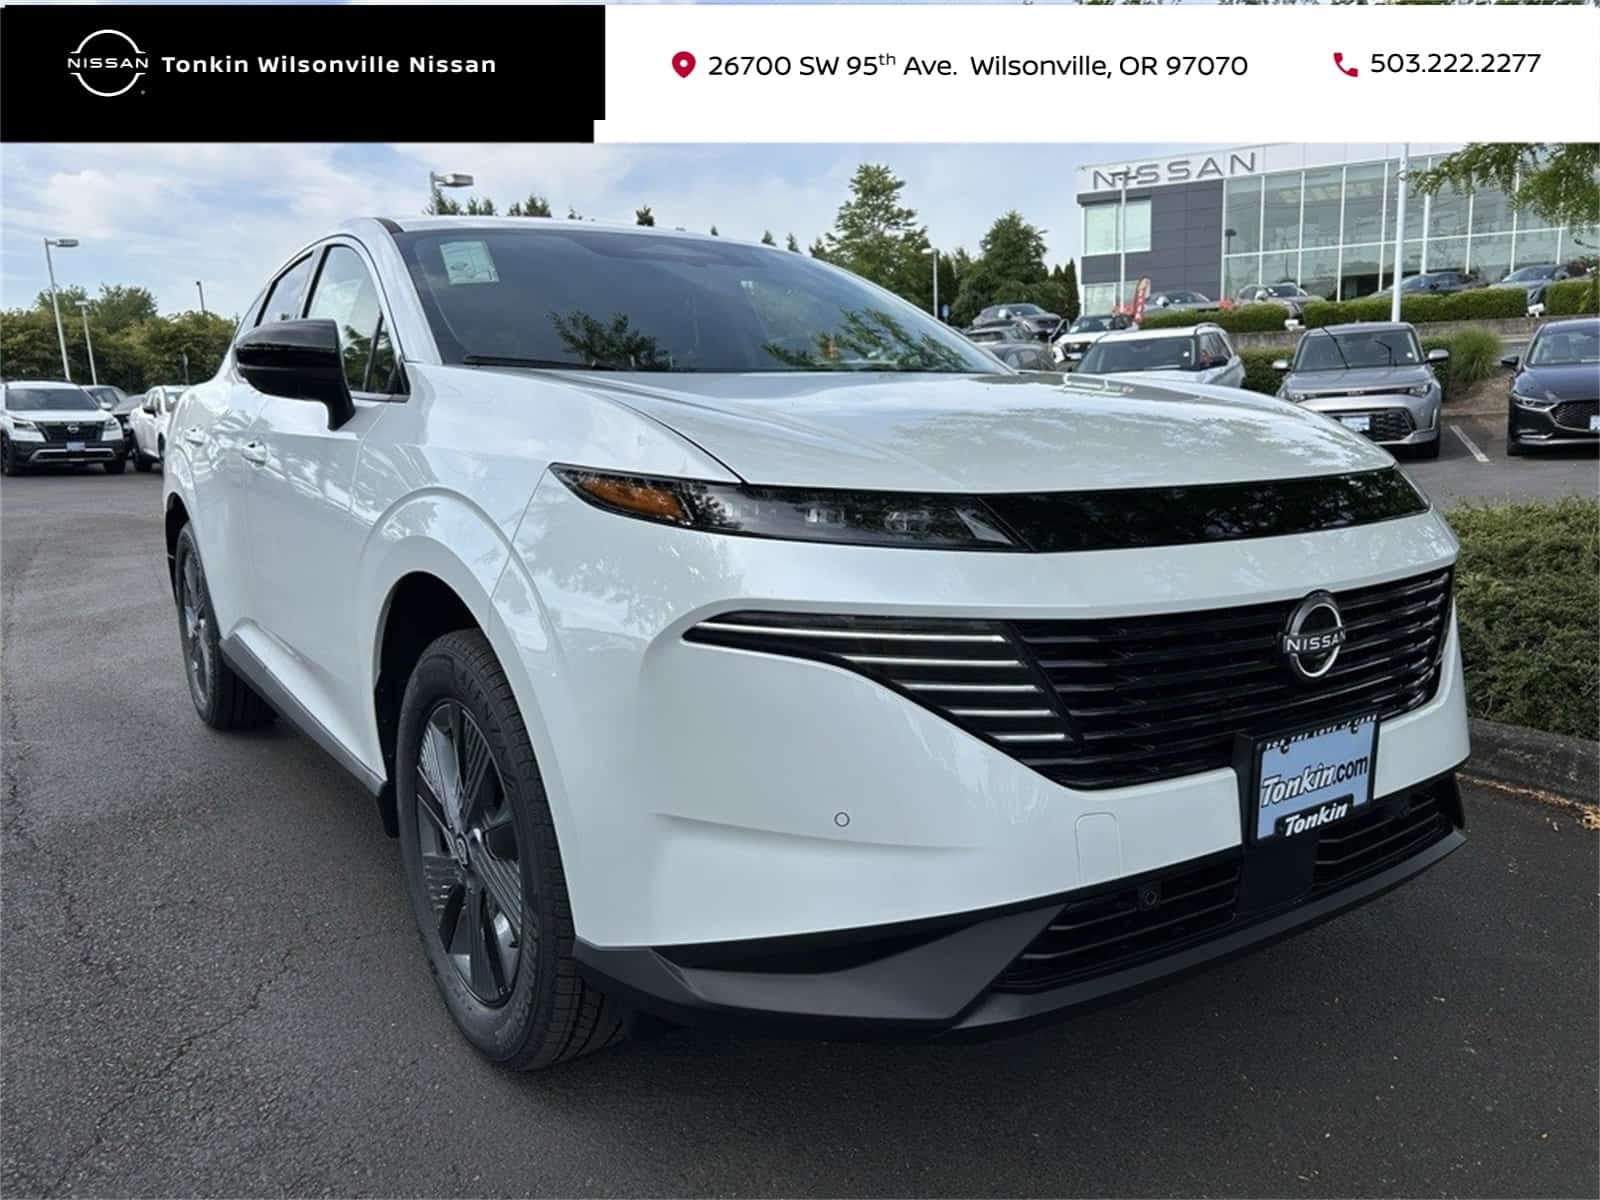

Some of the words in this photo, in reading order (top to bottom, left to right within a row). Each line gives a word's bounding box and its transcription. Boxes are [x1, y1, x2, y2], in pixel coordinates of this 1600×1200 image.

[1093, 152, 1255, 189] NISSAN
[1286, 626, 1346, 652] NISSAN
[1260, 756, 1368, 807] Tonkin.com
[1284, 802, 1347, 837] Tonkin
